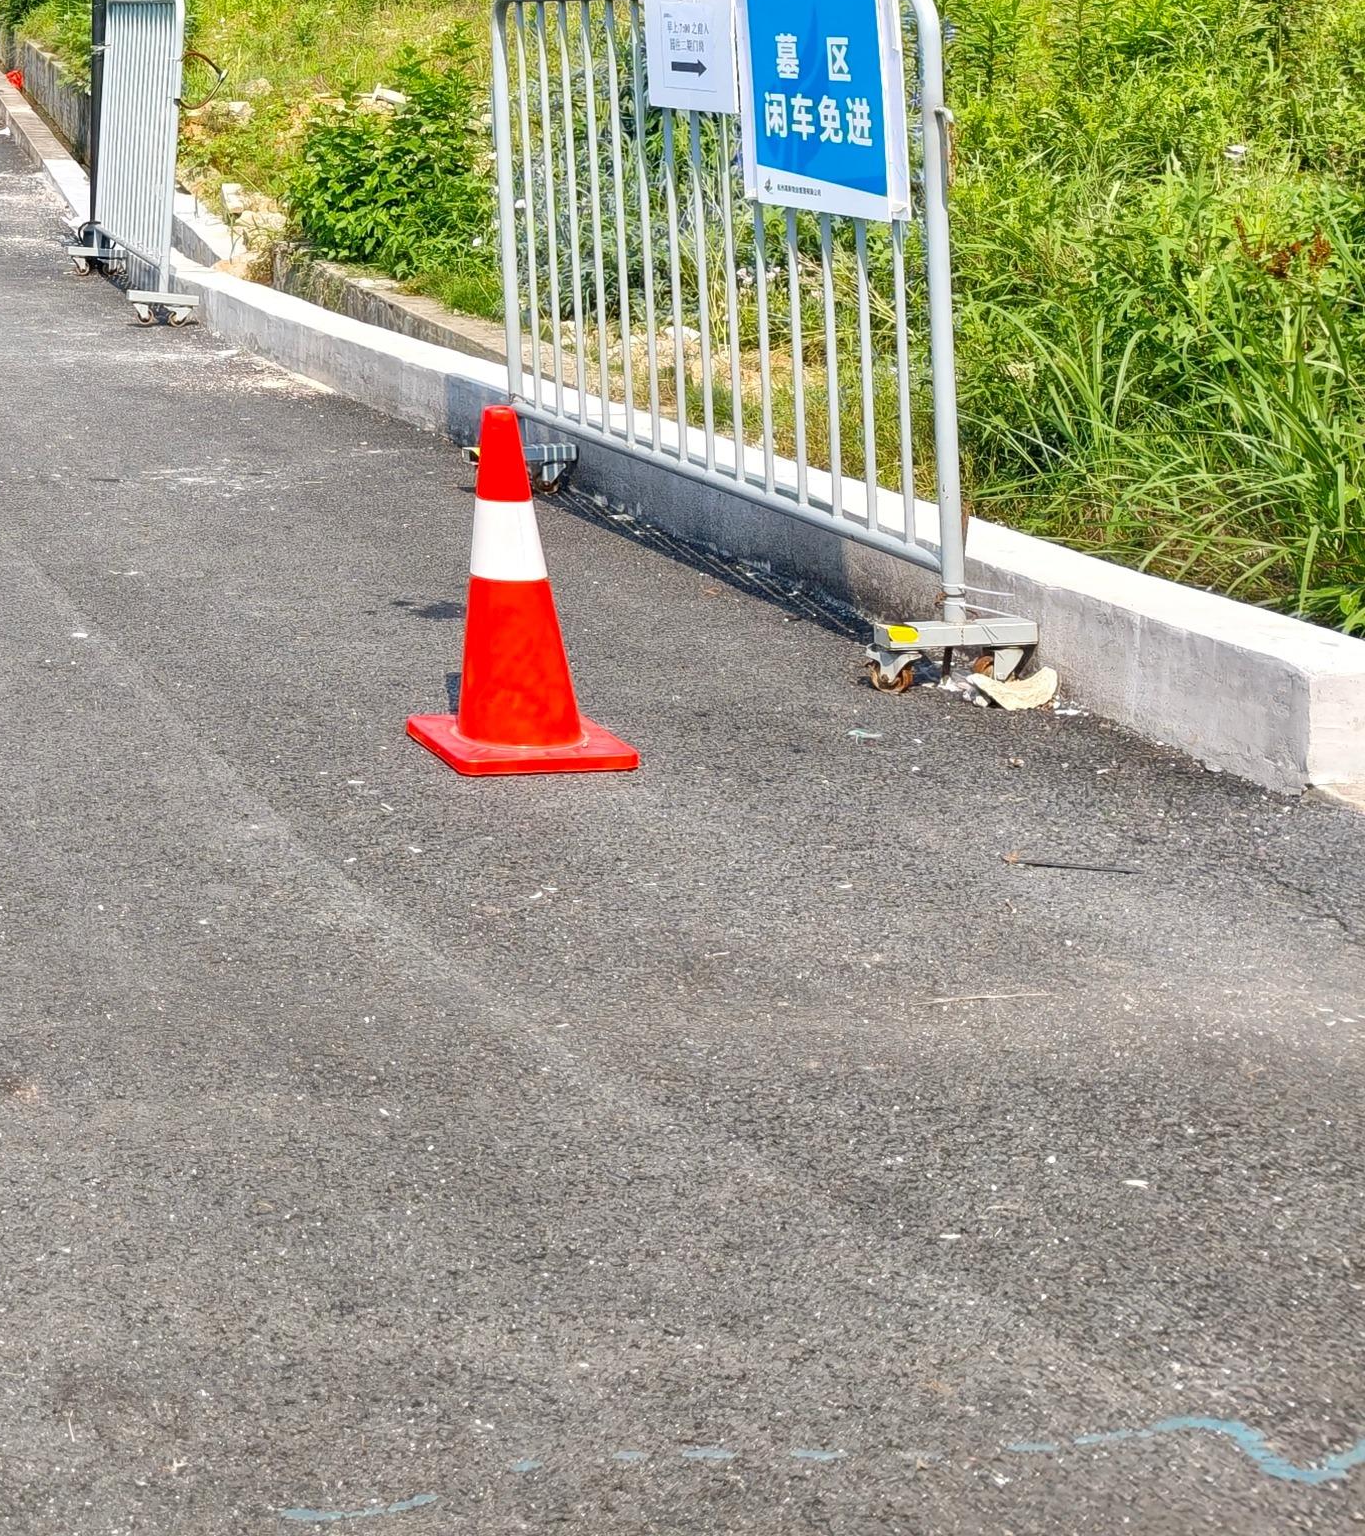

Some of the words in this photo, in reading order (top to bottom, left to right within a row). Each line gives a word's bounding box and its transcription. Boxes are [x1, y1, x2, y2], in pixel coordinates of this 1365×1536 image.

[775, 33, 851, 82] 墓区
[764, 92, 873, 147] 闲车免进
